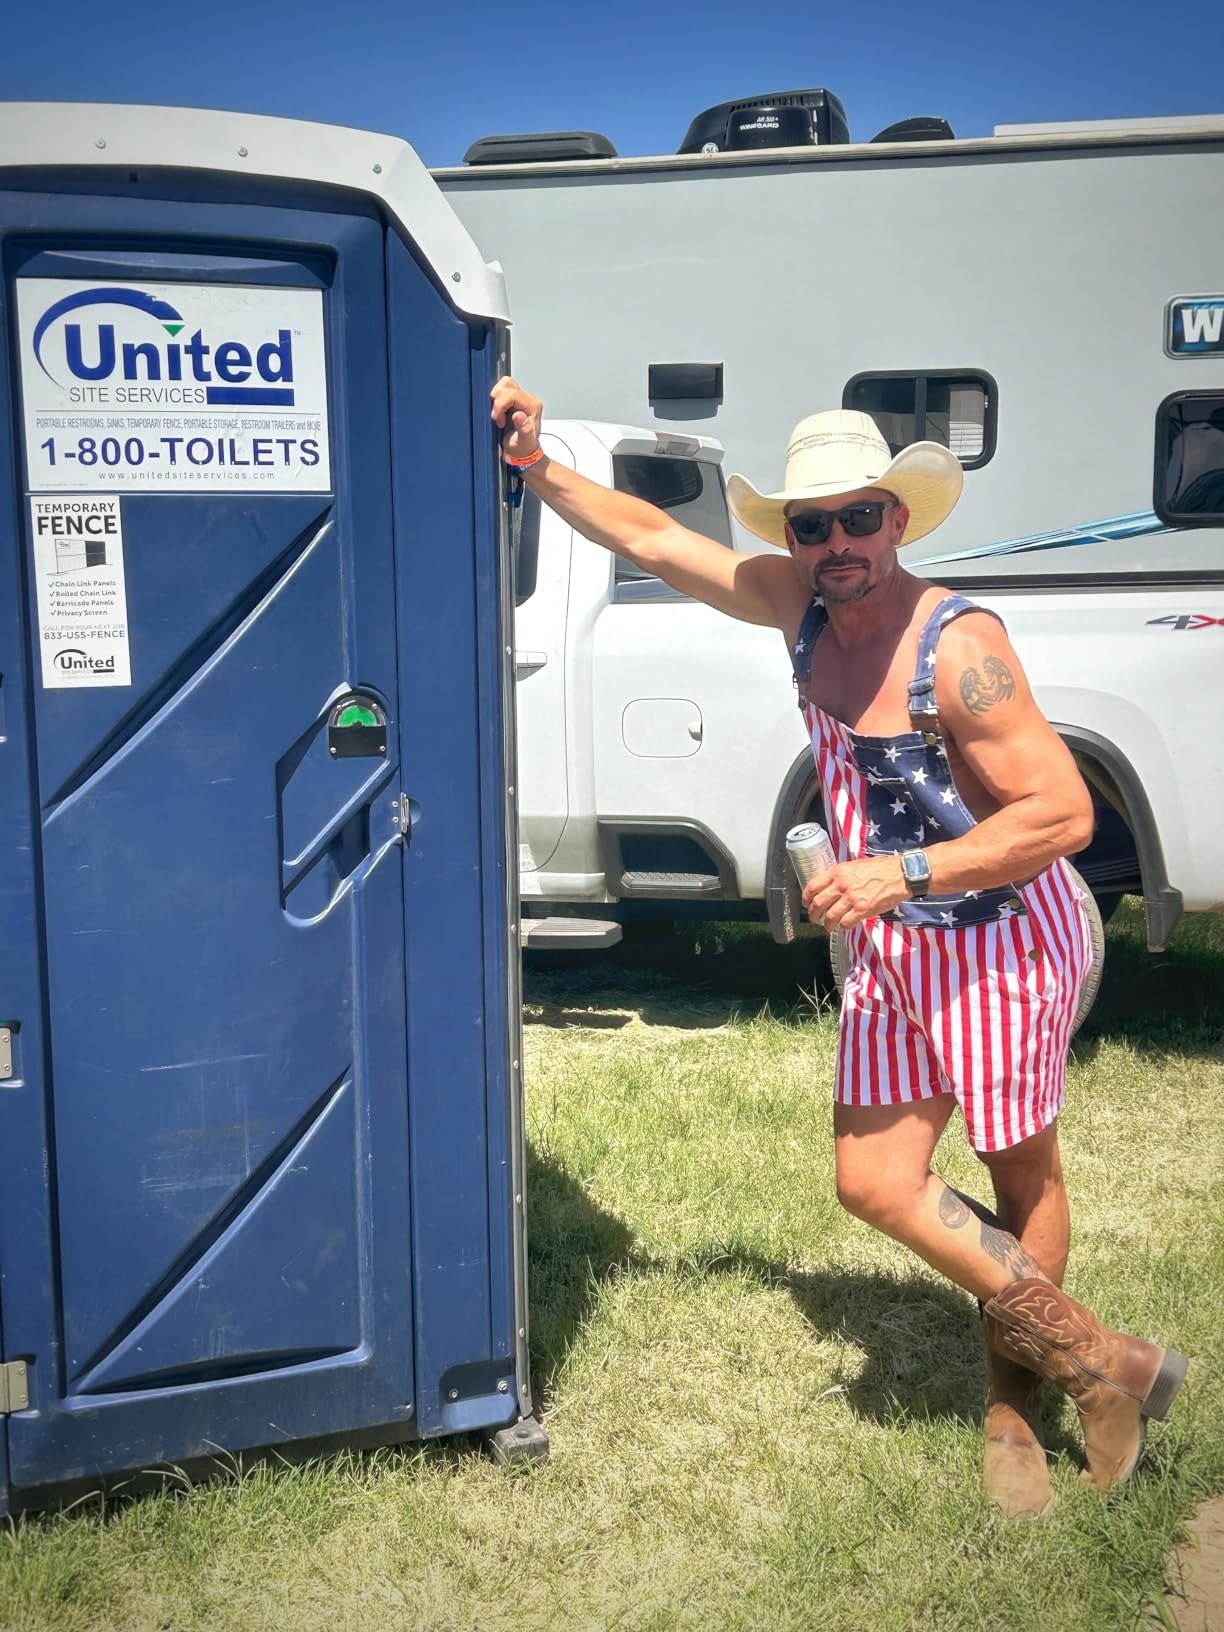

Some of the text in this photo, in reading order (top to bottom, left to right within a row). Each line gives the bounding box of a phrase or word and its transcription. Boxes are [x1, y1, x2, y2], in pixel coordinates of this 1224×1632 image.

[64, 324, 294, 383] United
[69, 387, 205, 404] SITE SERVICES
[36, 418, 66, 429] PORTABLE
[127, 418, 161, 429] TEMPORARY
[184, 418, 213, 429] PORTABLE
[241, 419, 270, 430] RESTROOM
[271, 420, 296, 430] TRAILERS
[296, 421, 306, 430] and
[40, 436, 321, 466] 1-800-TOILETS
[98, 471, 275, 481] www.unitedsiteservices.com
[35, 502, 115, 513] TEMPORARY
[37, 515, 118, 535] FENCE
[76, 579, 92, 587] Link
[44, 630, 126, 640] 833-USS-FENCE
[60, 655, 115, 669] United
